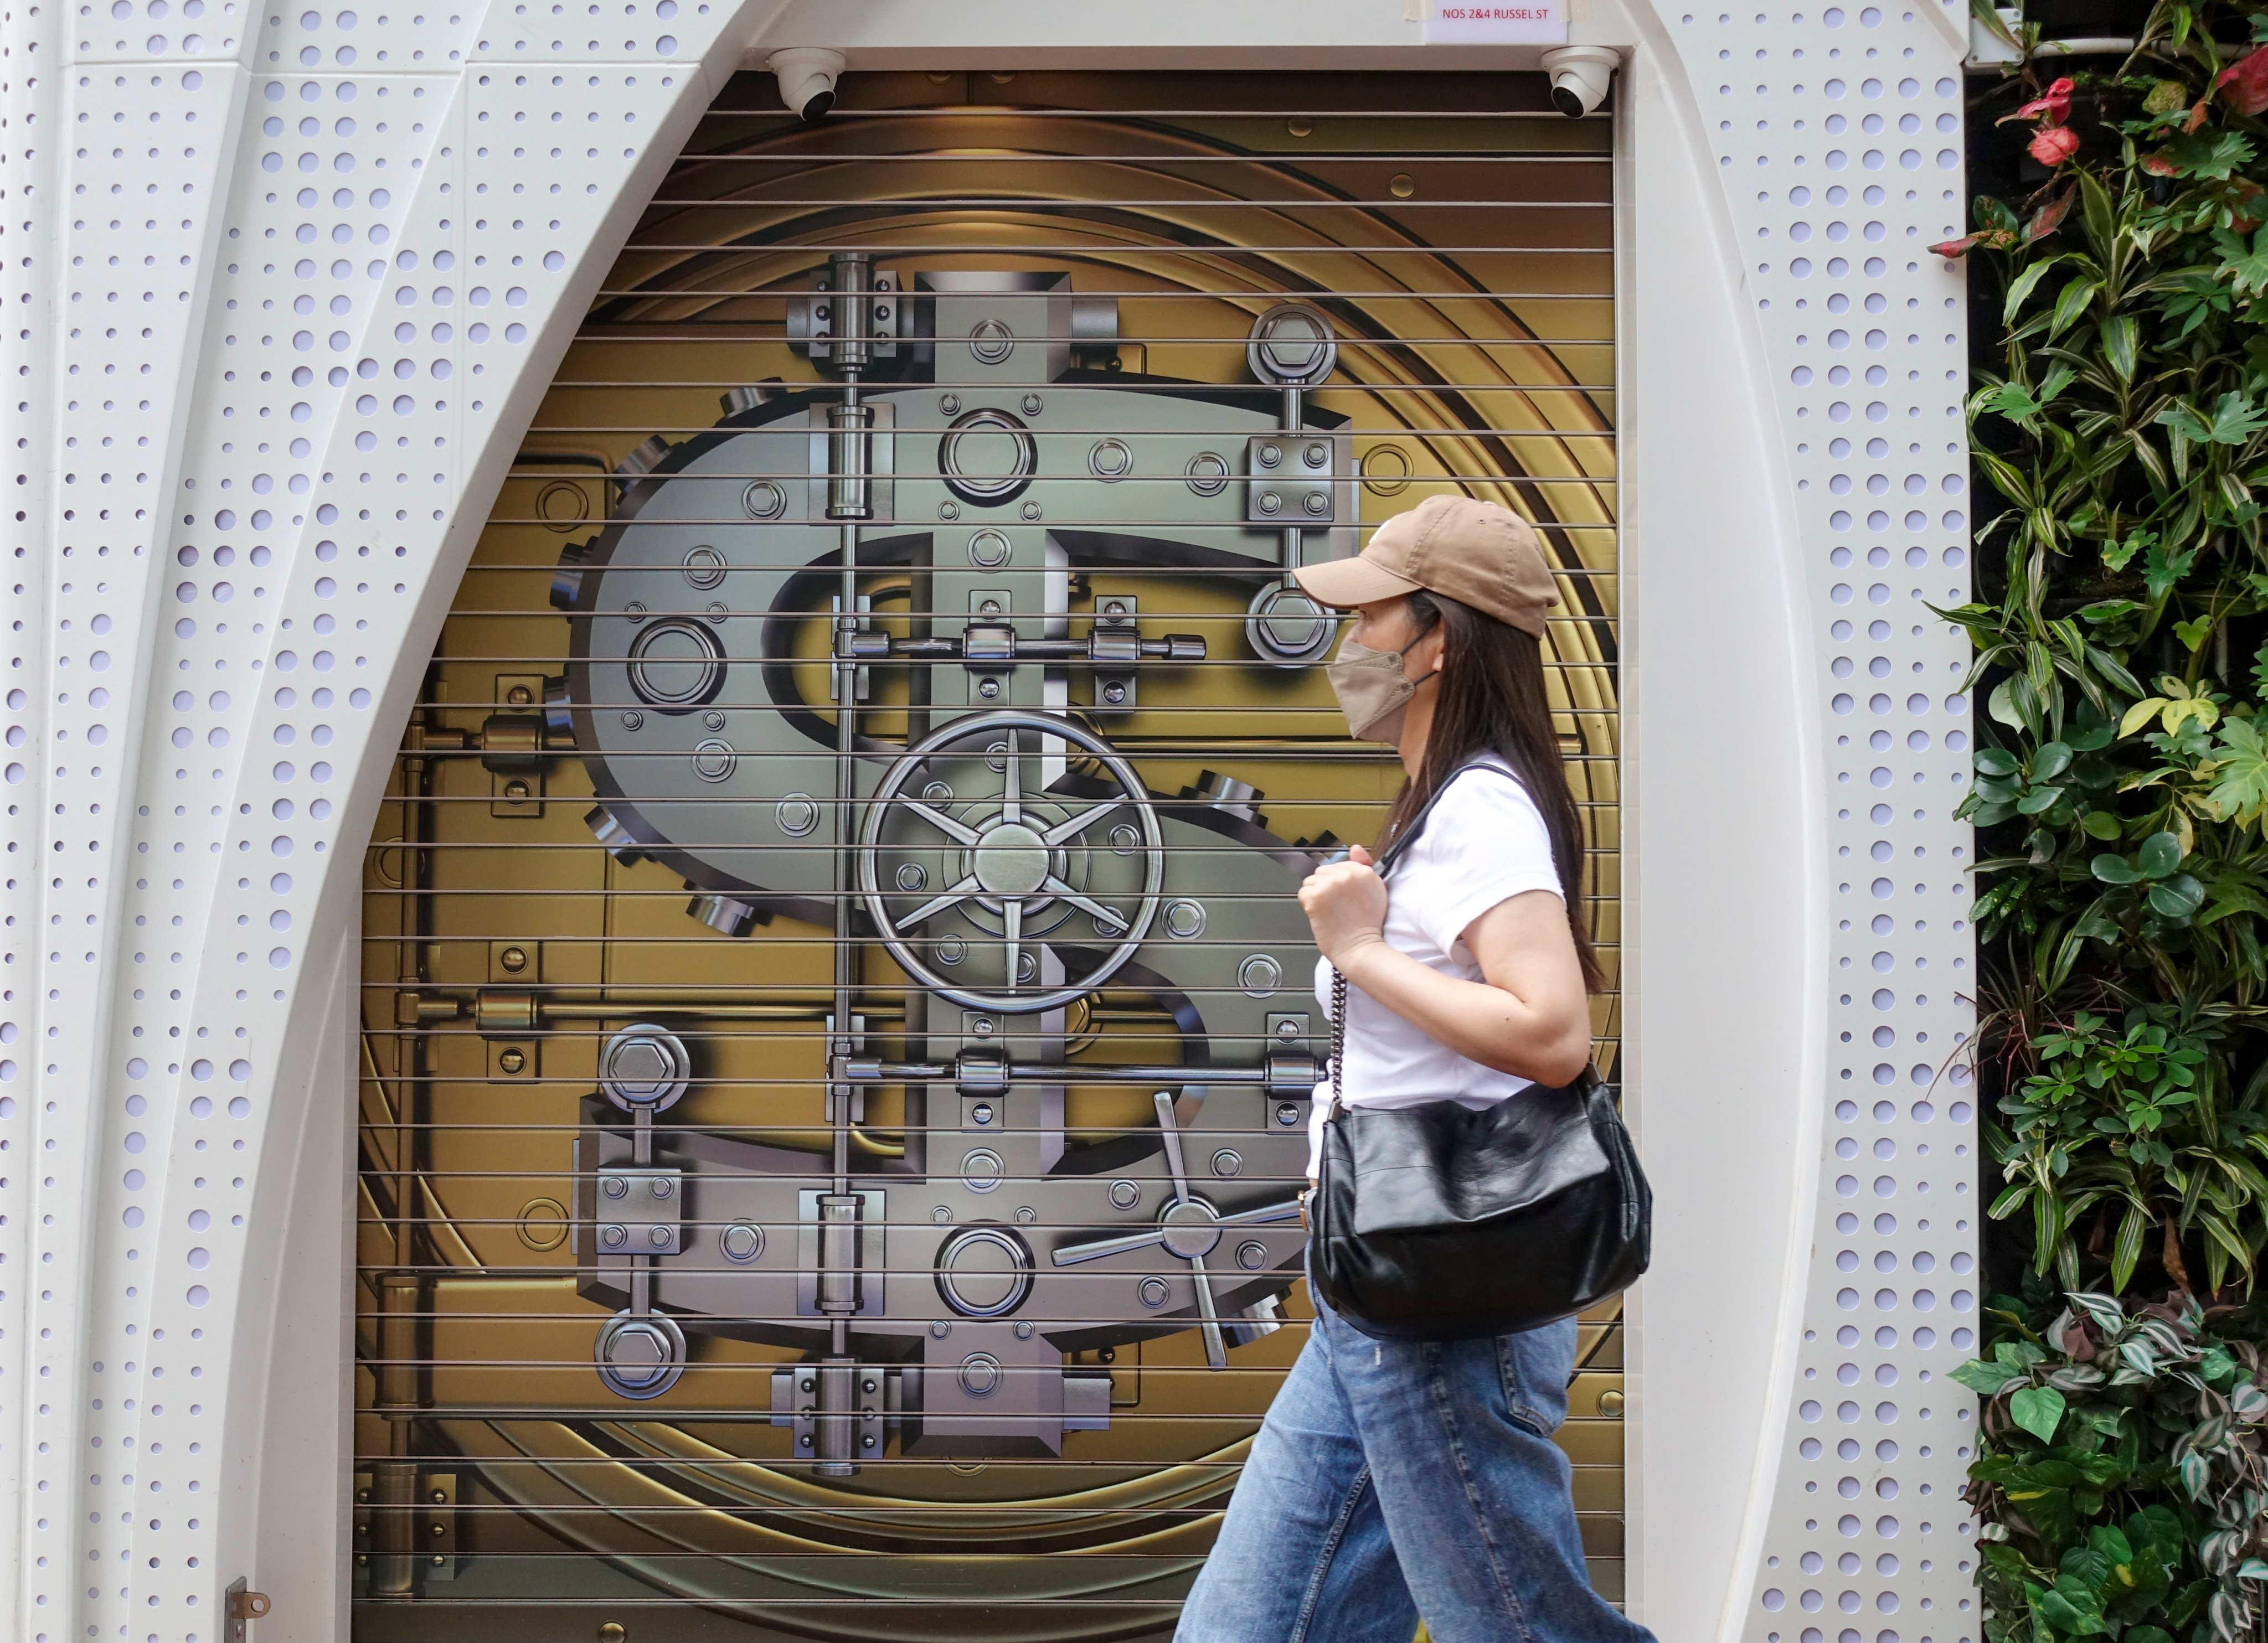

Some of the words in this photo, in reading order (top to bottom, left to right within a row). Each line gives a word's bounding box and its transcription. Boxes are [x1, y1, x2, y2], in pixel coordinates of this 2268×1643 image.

[1443, 8, 1465, 19] NOS
[1468, 8, 1491, 19] 2&4
[1494, 8, 1533, 19] RUSSEL
[1536, 8, 1549, 19] ST
